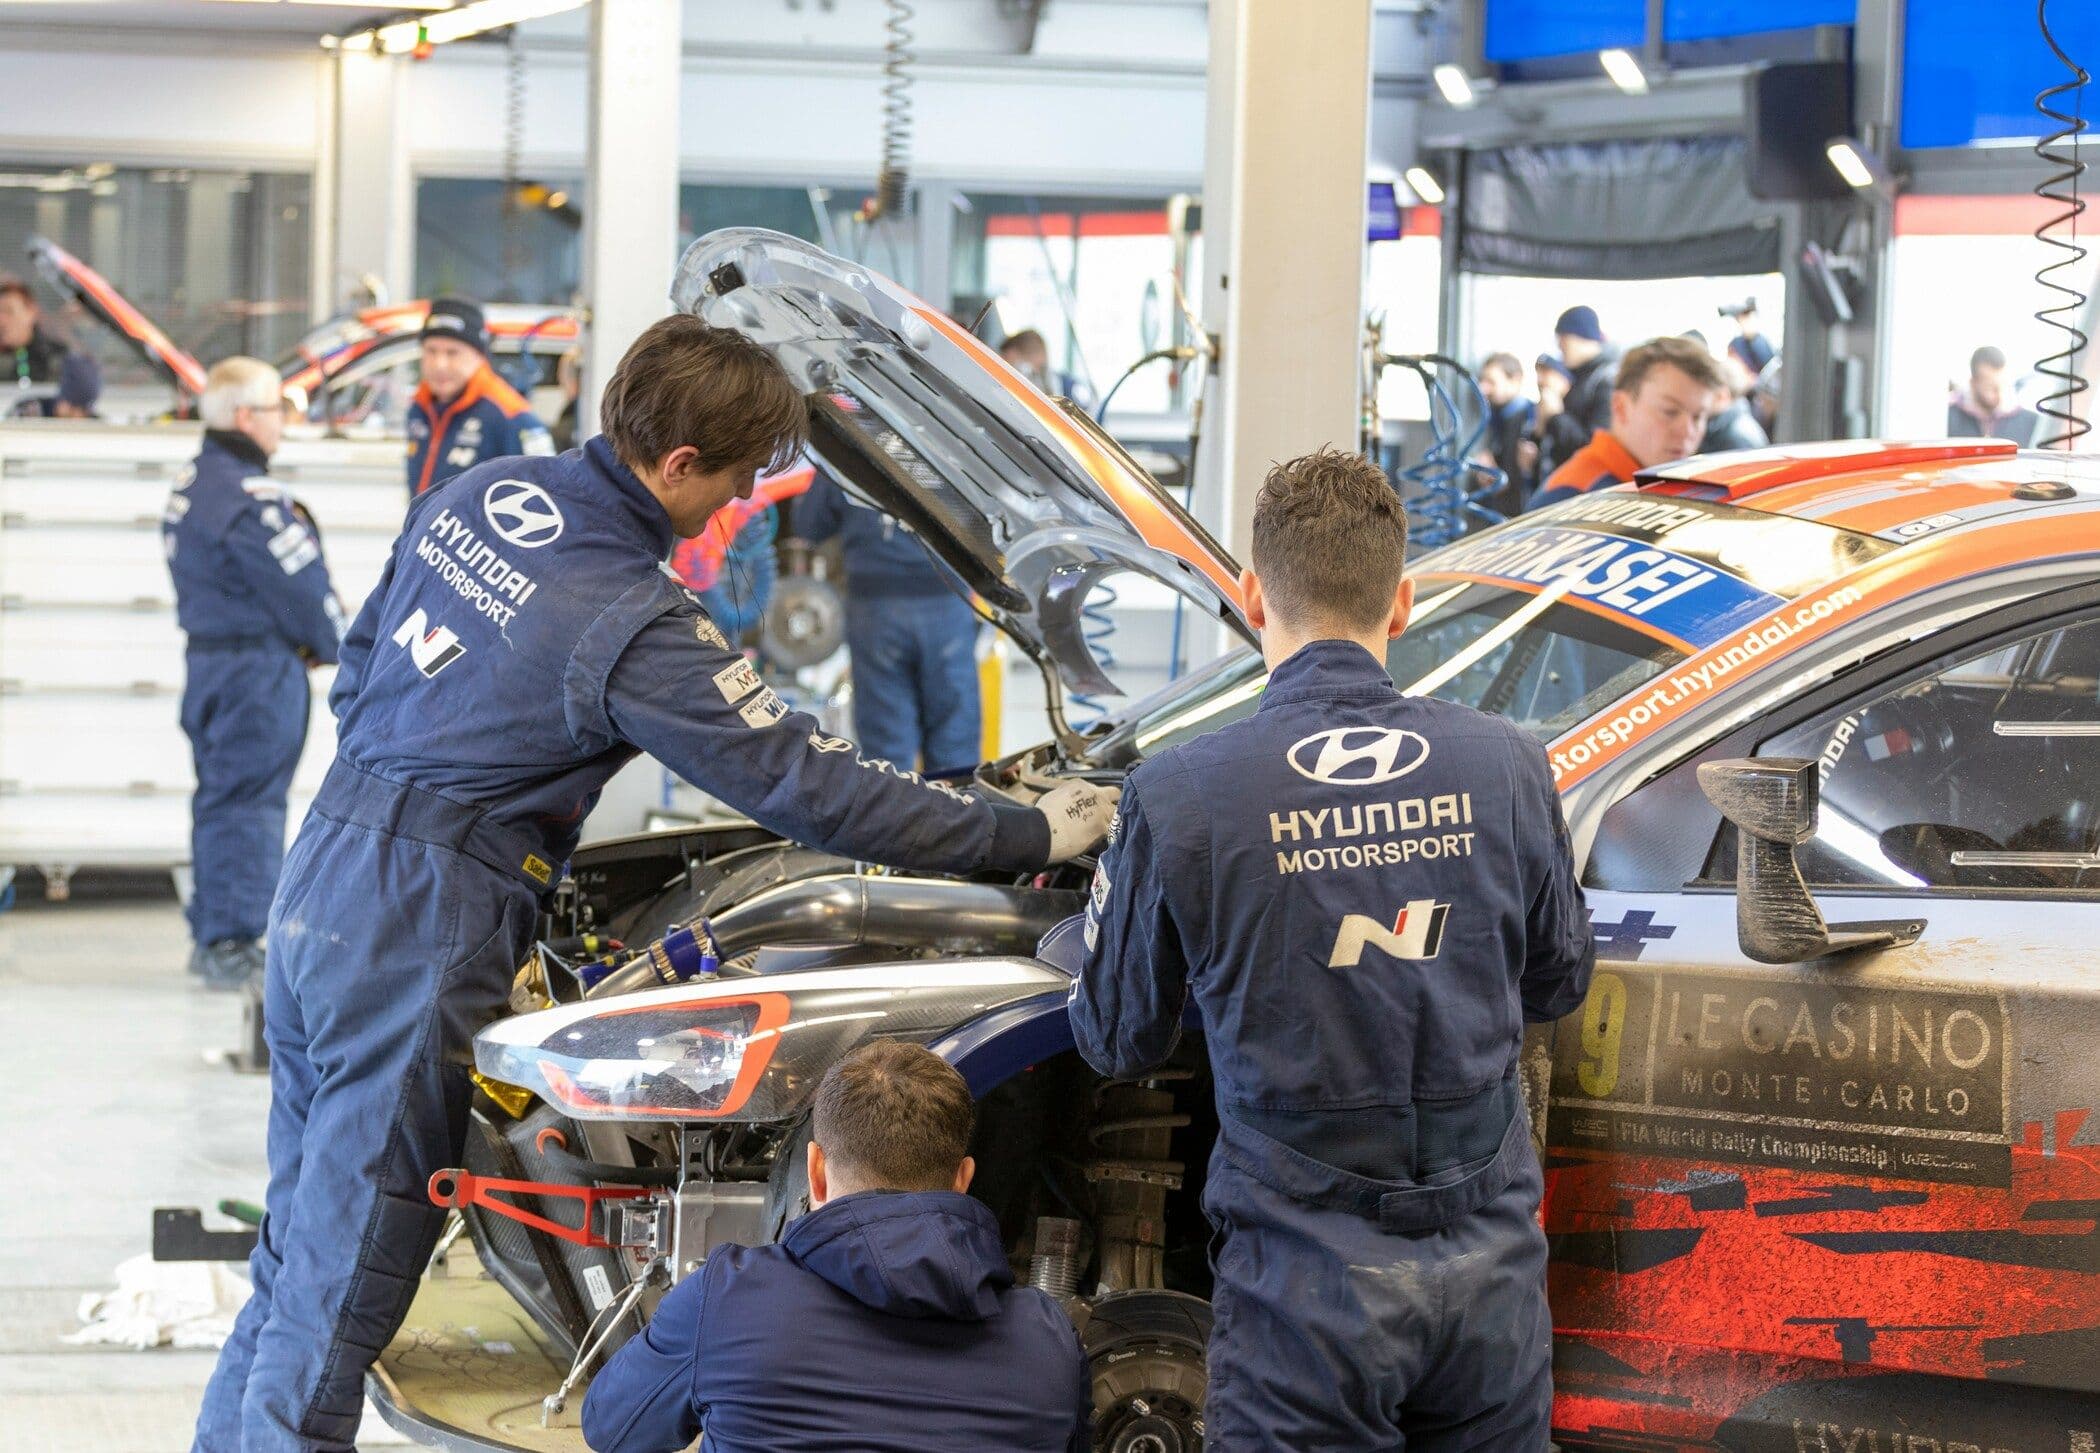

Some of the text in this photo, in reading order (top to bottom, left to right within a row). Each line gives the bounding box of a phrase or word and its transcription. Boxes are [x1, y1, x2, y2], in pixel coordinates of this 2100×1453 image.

[416, 535, 516, 627] MOTORSPORT
[429, 508, 538, 606] HYUNDAI
[392, 607, 467, 679] N
[1818, 716, 1859, 793] NDAI
[1066, 794, 1098, 819] HyFlex
[1269, 793, 1473, 843] HYUNDAI
[1277, 833, 1475, 875] MOTORSPORT
[1328, 899, 1451, 968] N
[1577, 973, 1627, 1097] 9
[1667, 990, 1991, 1069] LE CASINO
[1655, 1124, 1706, 1148] World
[1711, 1129, 1756, 1157] Rally
[1761, 1133, 1888, 1170] Championship
